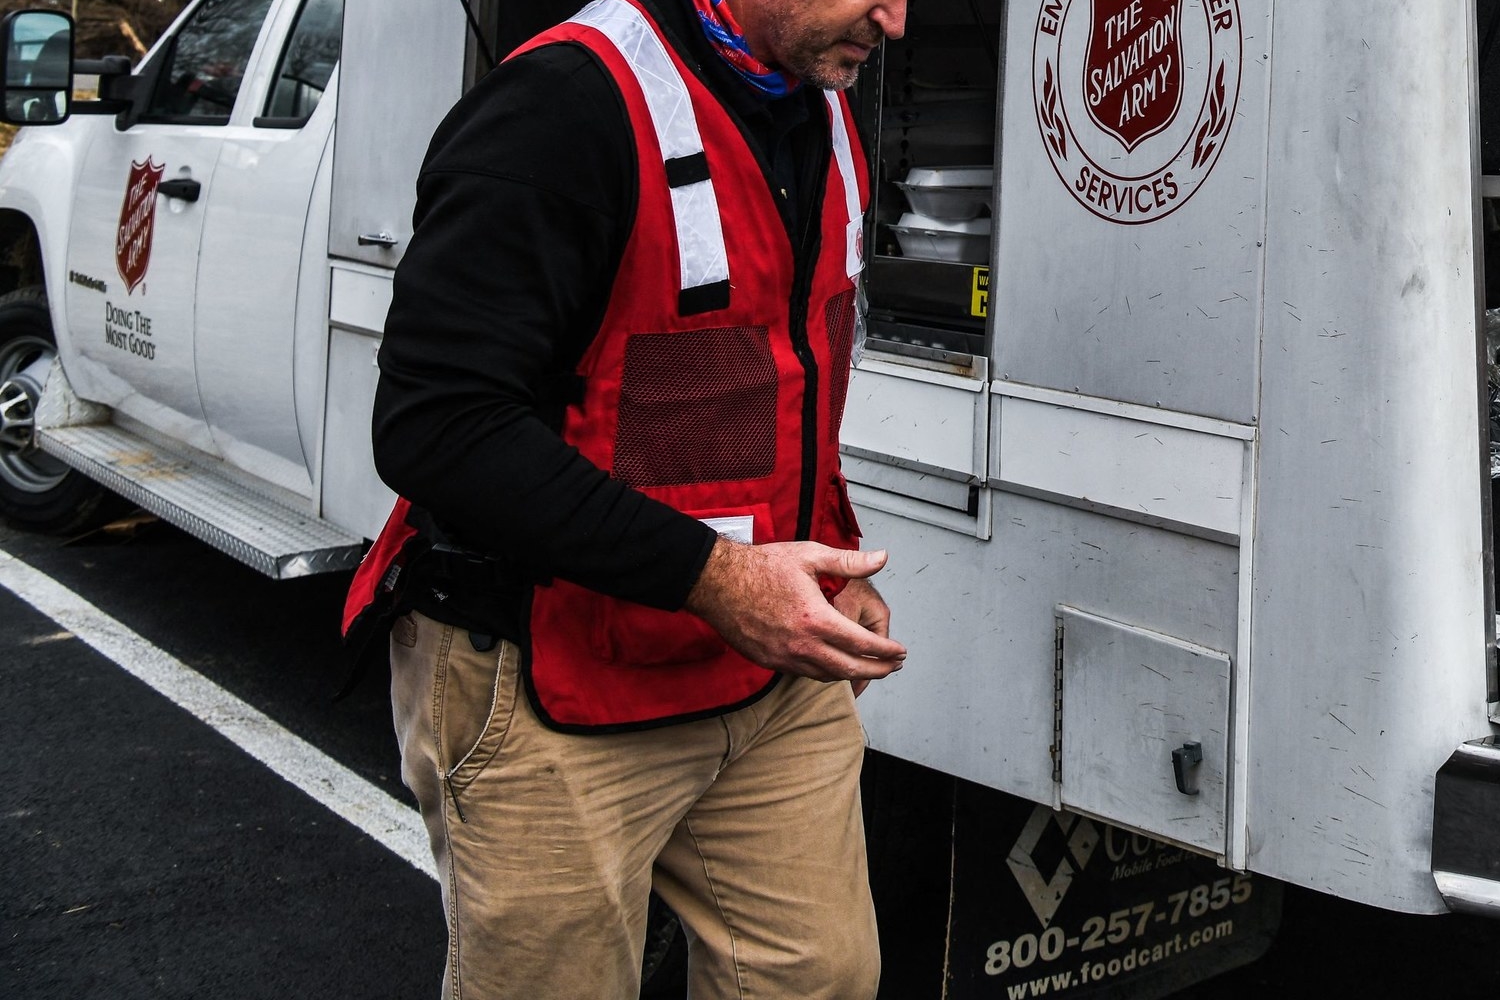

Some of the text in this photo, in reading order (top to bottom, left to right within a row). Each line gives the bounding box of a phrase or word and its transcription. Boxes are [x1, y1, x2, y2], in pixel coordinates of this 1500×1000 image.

[1090, 5, 1175, 107] SALVATION
[1118, 54, 1172, 128] ARMY
[128, 173, 148, 211] THE
[1075, 165, 1179, 214] SERVICES
[126, 219, 150, 273] ARMY
[1110, 859, 1153, 881] Mobile
[984, 874, 1254, 977] 800-257-7855
[1007, 917, 1234, 1000] www.foodcart.com
